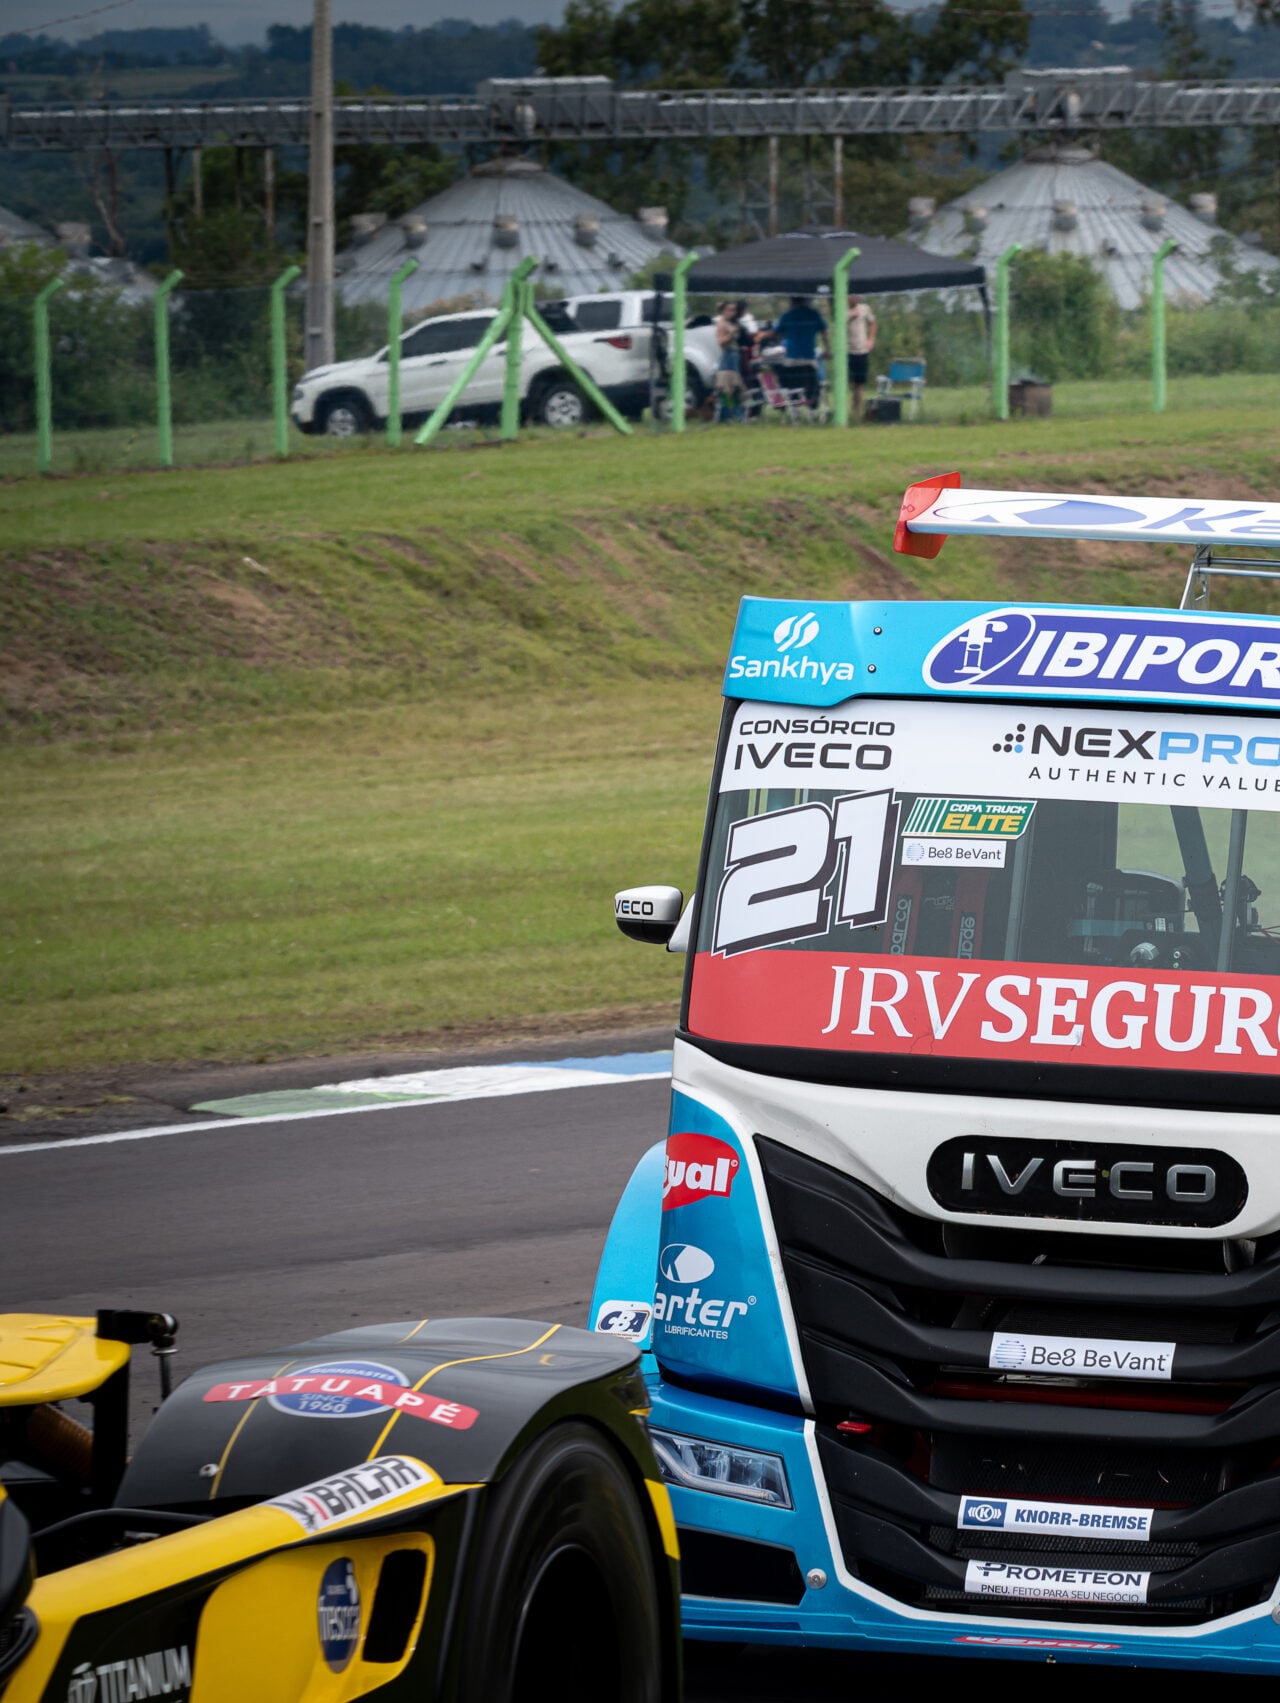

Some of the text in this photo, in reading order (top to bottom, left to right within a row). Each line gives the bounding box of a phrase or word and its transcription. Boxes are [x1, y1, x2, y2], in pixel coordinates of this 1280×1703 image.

[729, 654, 855, 686] Sankhya
[739, 715, 896, 737] CONSÓRCIO
[733, 742, 893, 771] IVECO
[1028, 766, 1187, 788] AUTHENTIC
[949, 802, 1028, 815] COPA TRUCK
[941, 813, 1022, 834] ELITE
[928, 846, 1002, 861] Be8 BeVant
[711, 787, 902, 959] 21
[960, 1151, 1217, 1203] IVECO
[600, 1310, 649, 1332] CBA
[664, 1323, 729, 1340] LUBRIFICANTES
[1031, 1346, 1167, 1372] Be8 BeVant
[309, 1367, 396, 1382] GUINDASTES
[227, 1377, 462, 1425] TATUAPÉ
[298, 1401, 347, 1414] 1960
[301, 1393, 351, 1405] SINCE
[1014, 1508, 1149, 1531] KNORR-BREMSE
[977, 1561, 1143, 1587] PROMETEON
[981, 1584, 1139, 1602] PNEU. FEITO PARA SEU NEGÓCIO
